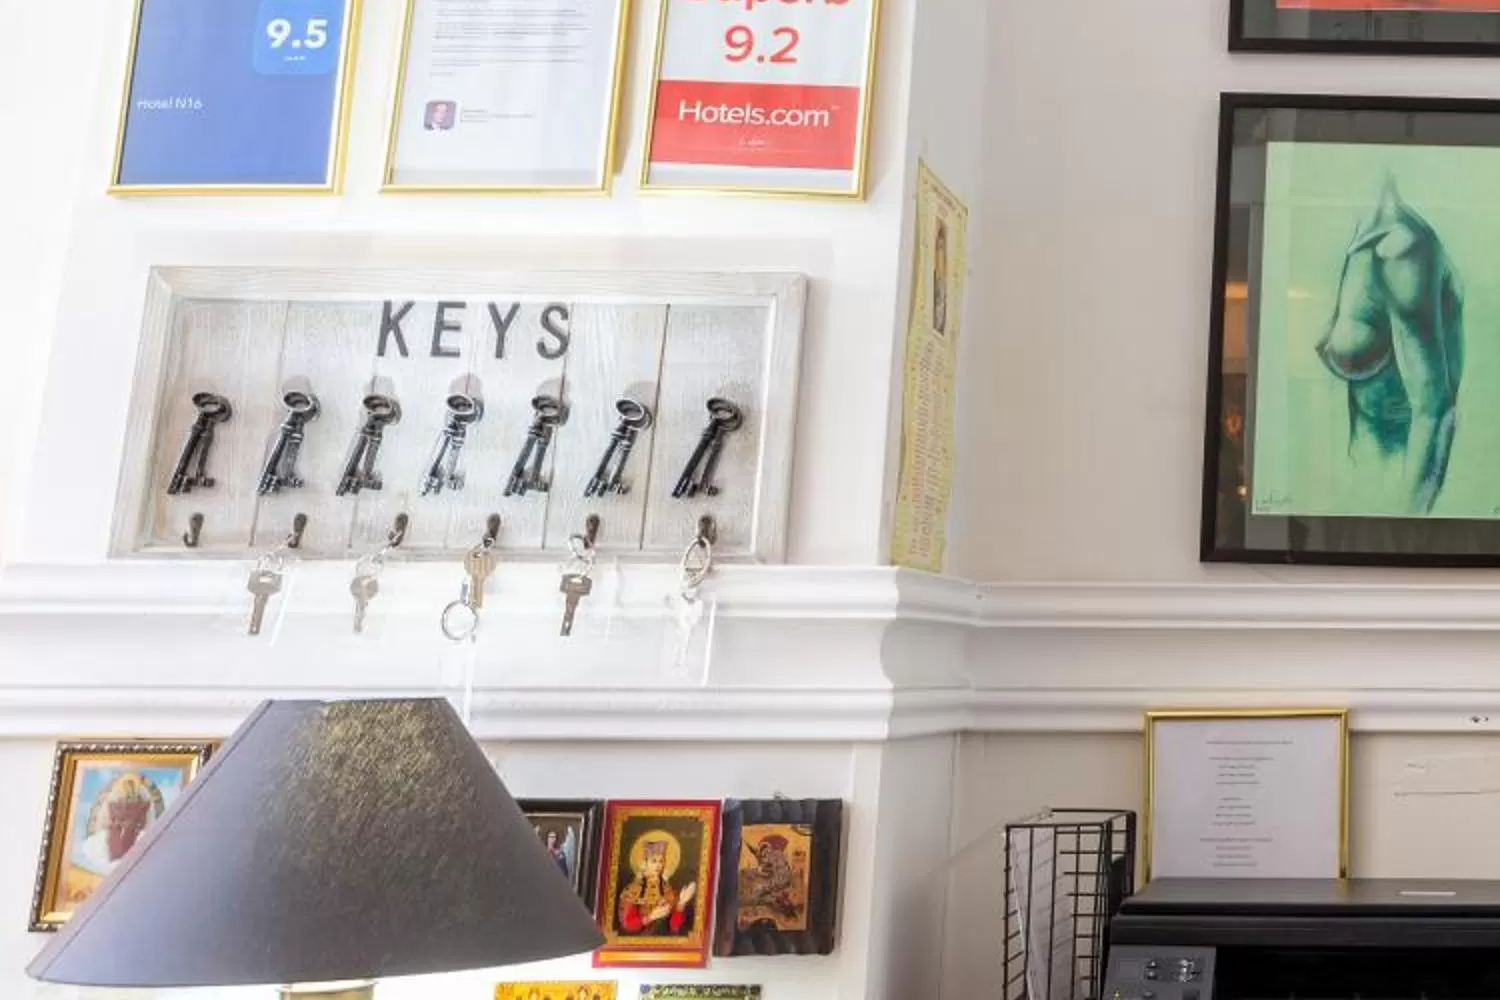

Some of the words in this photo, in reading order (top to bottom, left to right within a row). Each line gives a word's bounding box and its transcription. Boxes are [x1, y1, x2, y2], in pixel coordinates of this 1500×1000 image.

[266, 18, 328, 49] 9.5
[724, 25, 800, 64] 9.2
[137, 97, 173, 110] Hotel
[175, 97, 203, 110] N16
[679, 100, 829, 127] Hotels.com
[377, 299, 570, 361] KEYS
